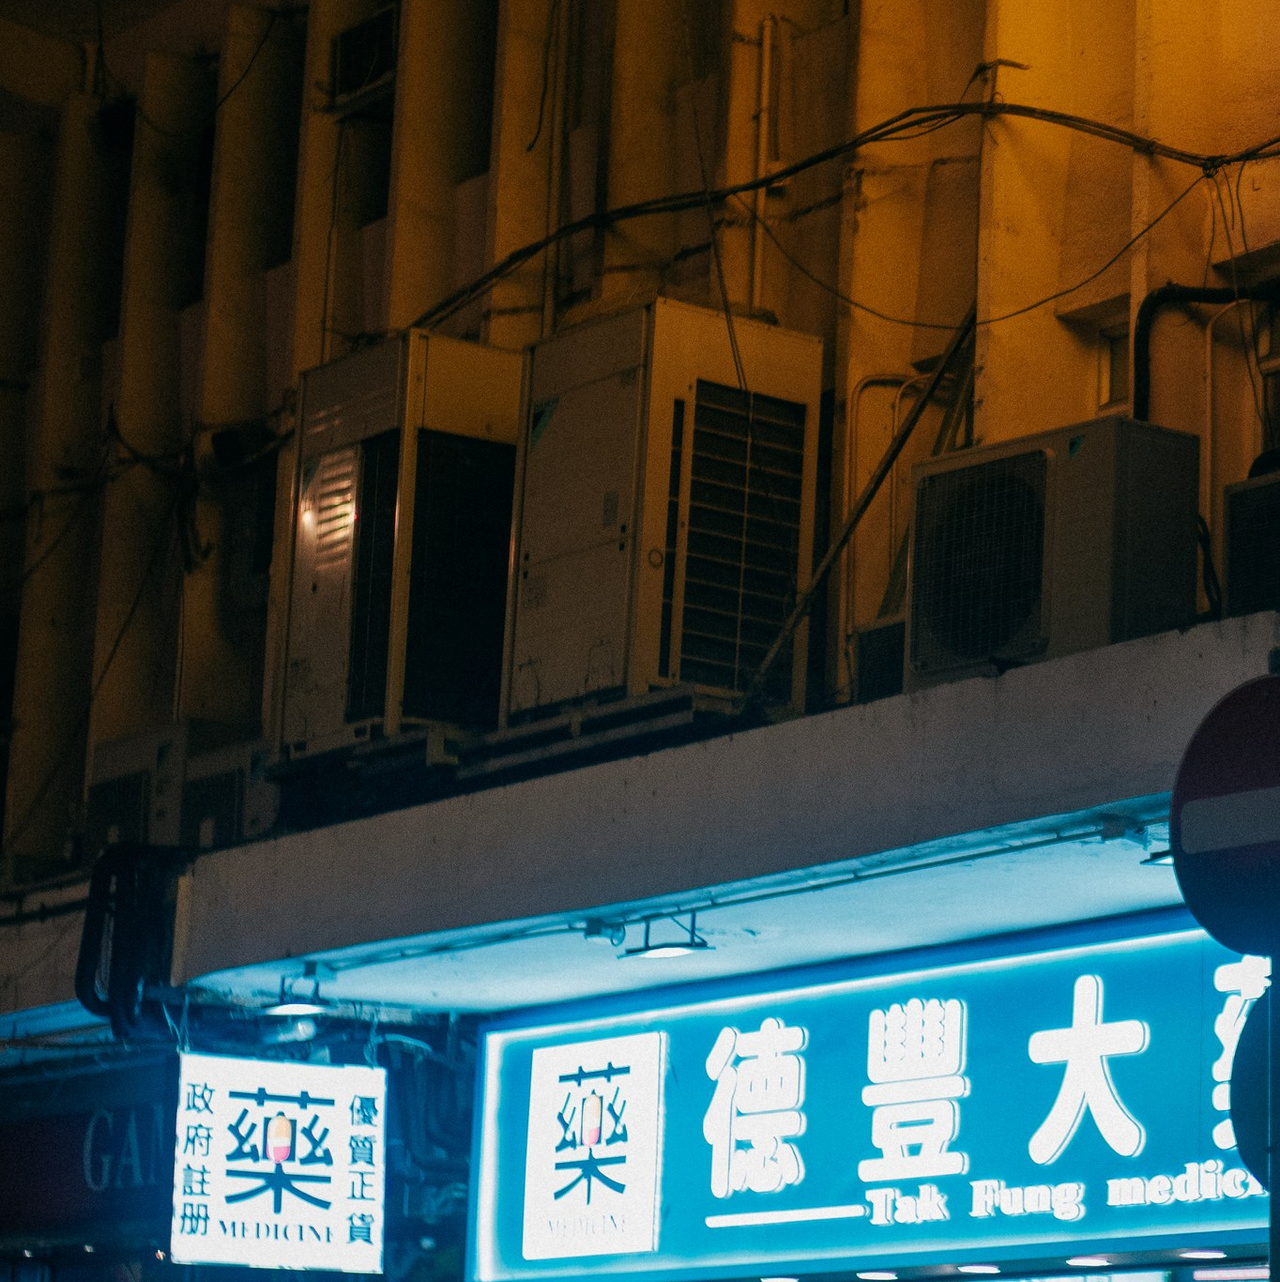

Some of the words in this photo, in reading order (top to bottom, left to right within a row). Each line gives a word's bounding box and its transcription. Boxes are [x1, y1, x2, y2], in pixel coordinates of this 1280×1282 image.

[225, 1088, 335, 1213] 藥
[347, 1094, 379, 1245] 優質正貨
[553, 1061, 631, 1205] 藥
[866, 1186, 949, 1226] Tak
[970, 1178, 1087, 1222] Fung
[1106, 1159, 1271, 1208] medic
[219, 1218, 334, 1245] MEDICINE
